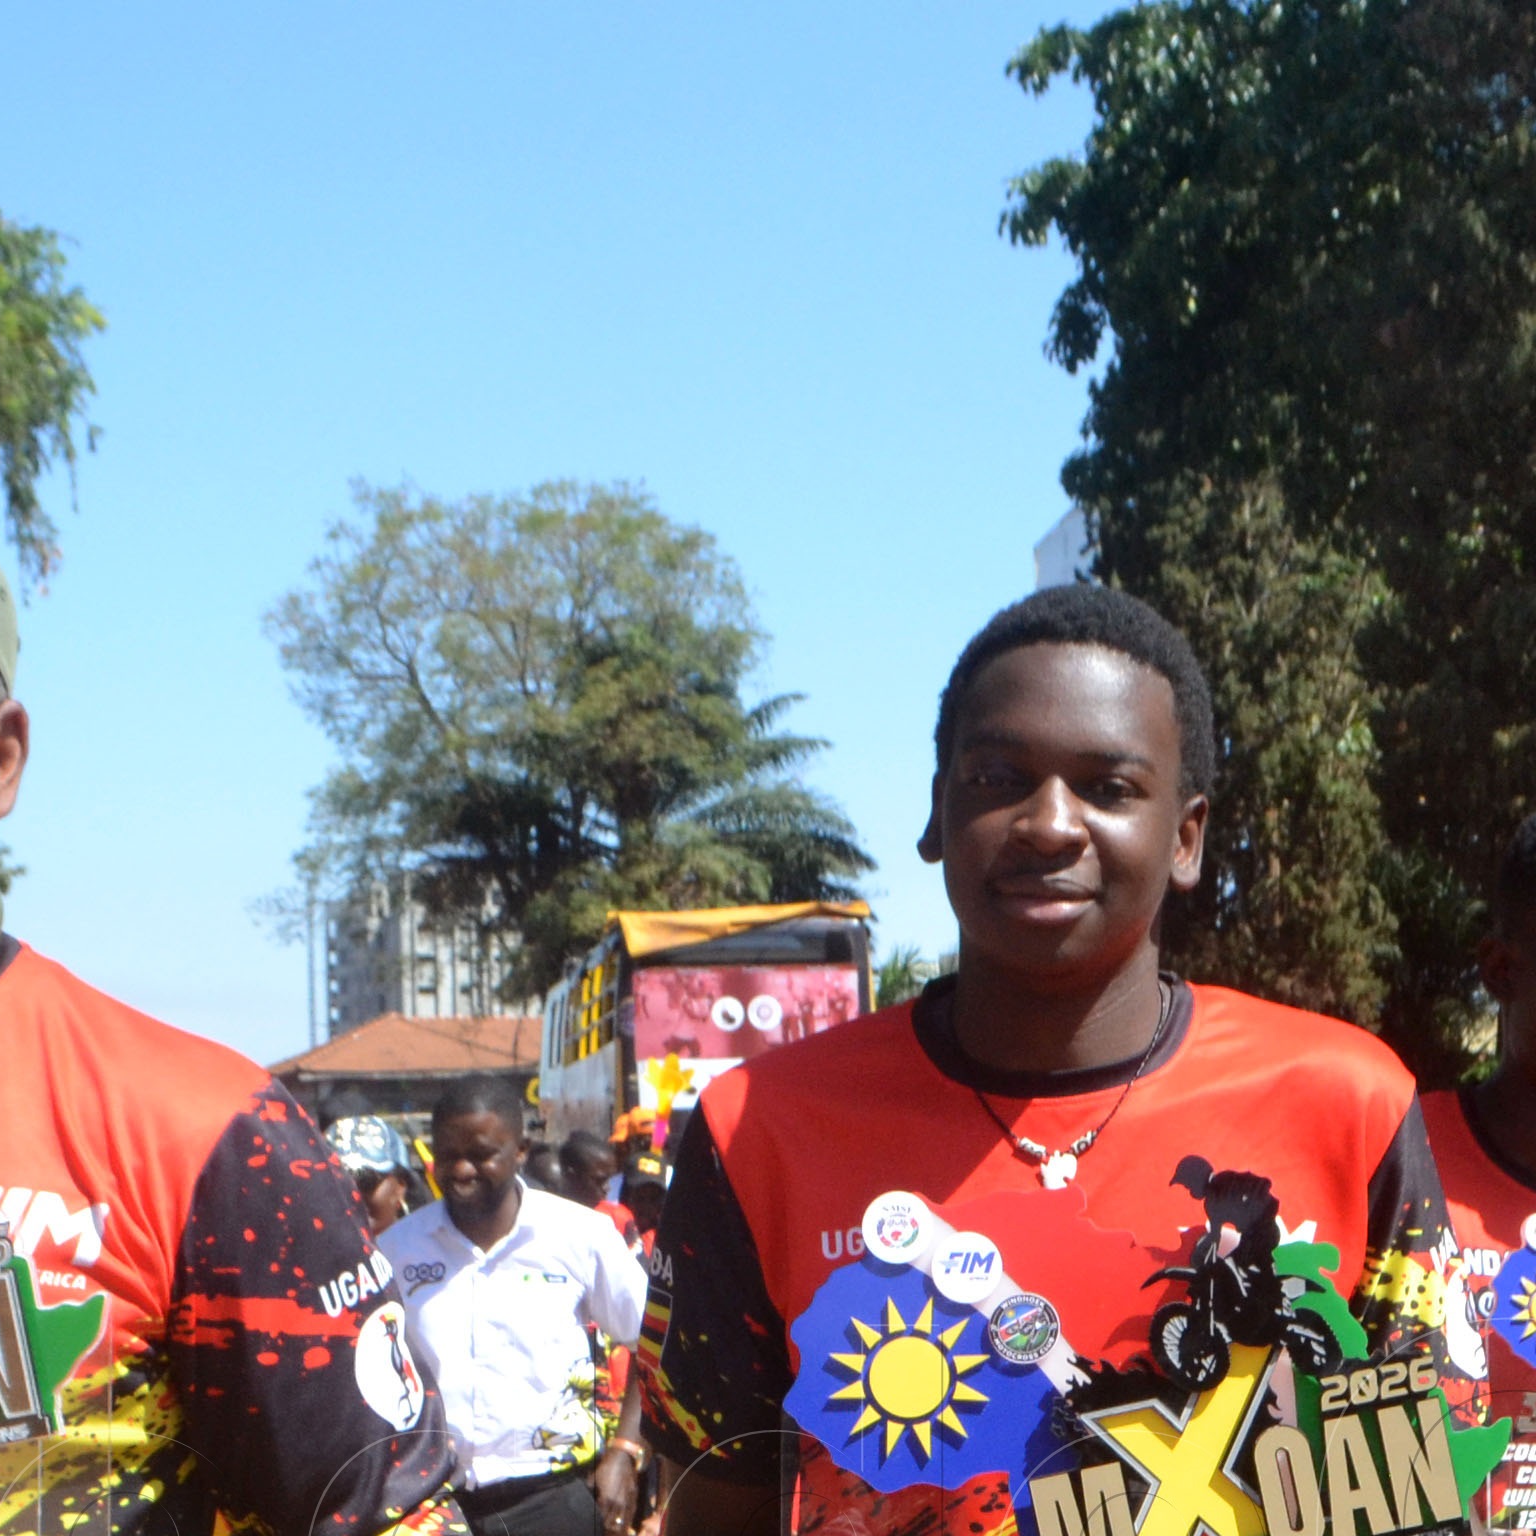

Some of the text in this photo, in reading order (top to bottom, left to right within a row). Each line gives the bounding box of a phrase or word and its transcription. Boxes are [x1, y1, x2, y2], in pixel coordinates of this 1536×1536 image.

[942, 1251, 996, 1275] FIM
[39, 1269, 88, 1291] RICA
[1320, 1356, 1439, 1412] 2026
